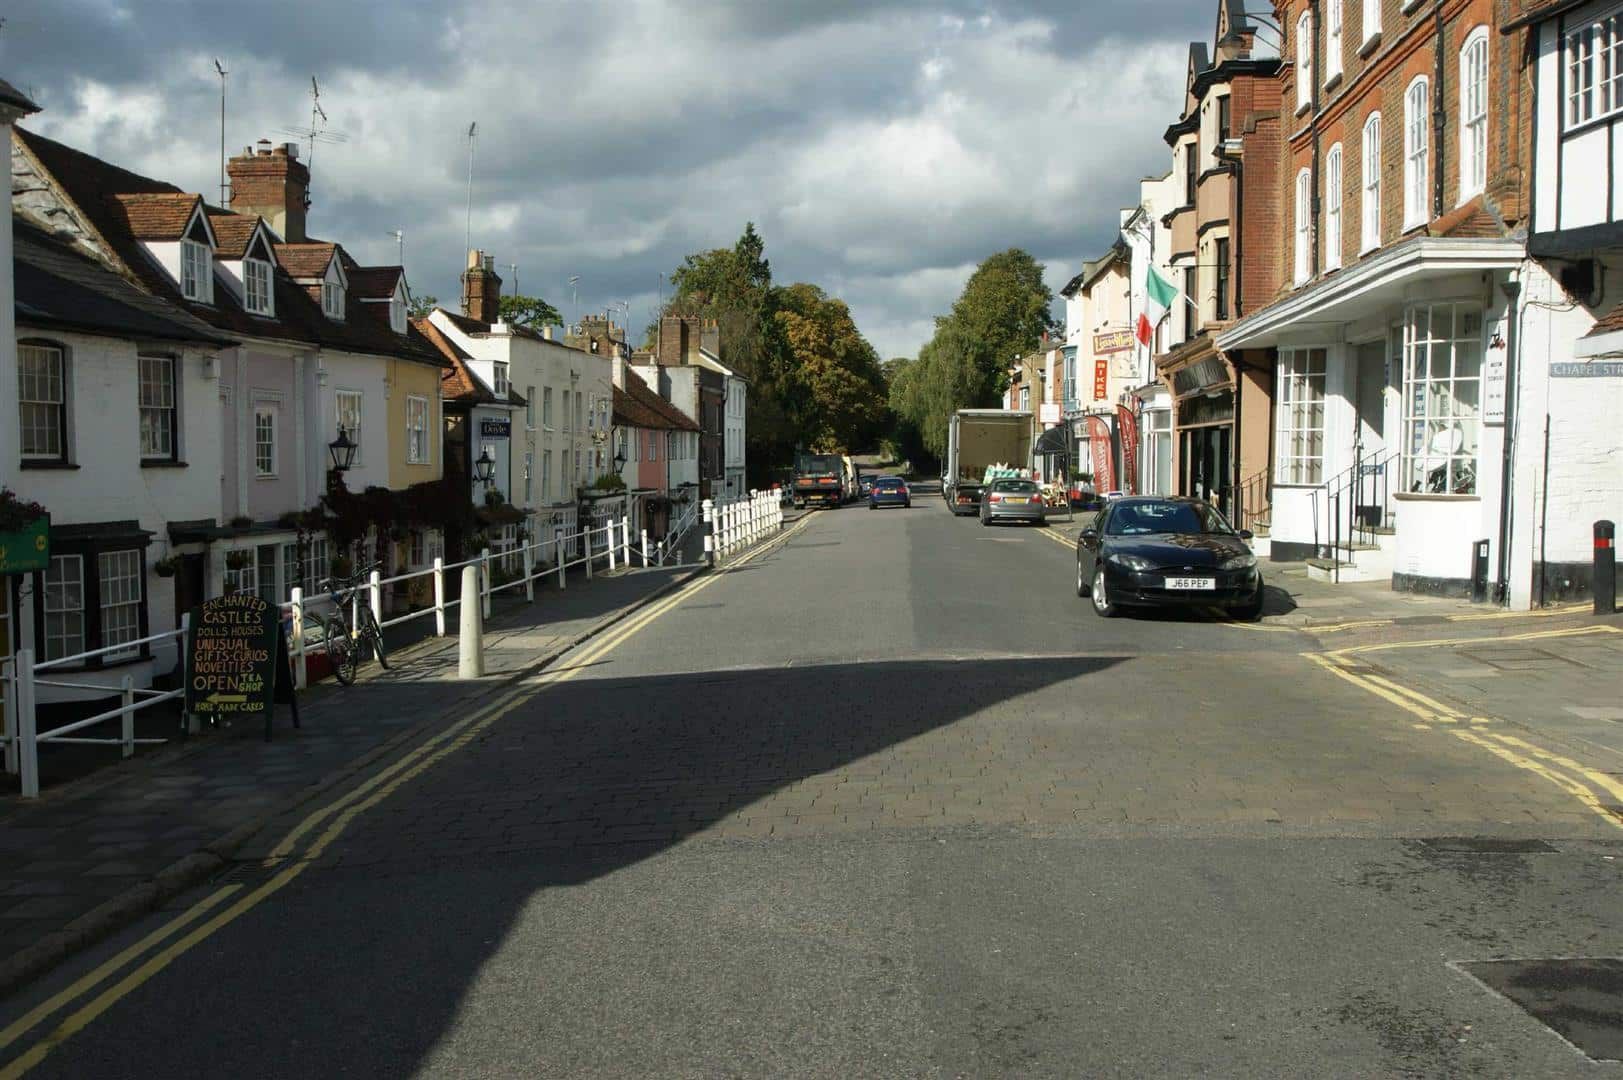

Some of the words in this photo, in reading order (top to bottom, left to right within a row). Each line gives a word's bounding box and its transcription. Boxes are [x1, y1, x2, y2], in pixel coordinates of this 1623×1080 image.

[1552, 364, 1597, 375] CHAPEL
[1097, 362, 1106, 396] BIKES
[202, 594, 267, 612] ENCHANTED
[203, 611, 262, 624] CASTLES
[197, 626, 228, 637] DOLLS
[231, 625, 264, 636] HOUSES
[196, 639, 250, 650] UNUSUAL
[195, 661, 255, 673] NOVELTIES
[193, 675, 239, 690] OPEN
[240, 673, 263, 682] TEA
[239, 682, 264, 692] SHOP
[240, 703, 264, 712] CAKES
